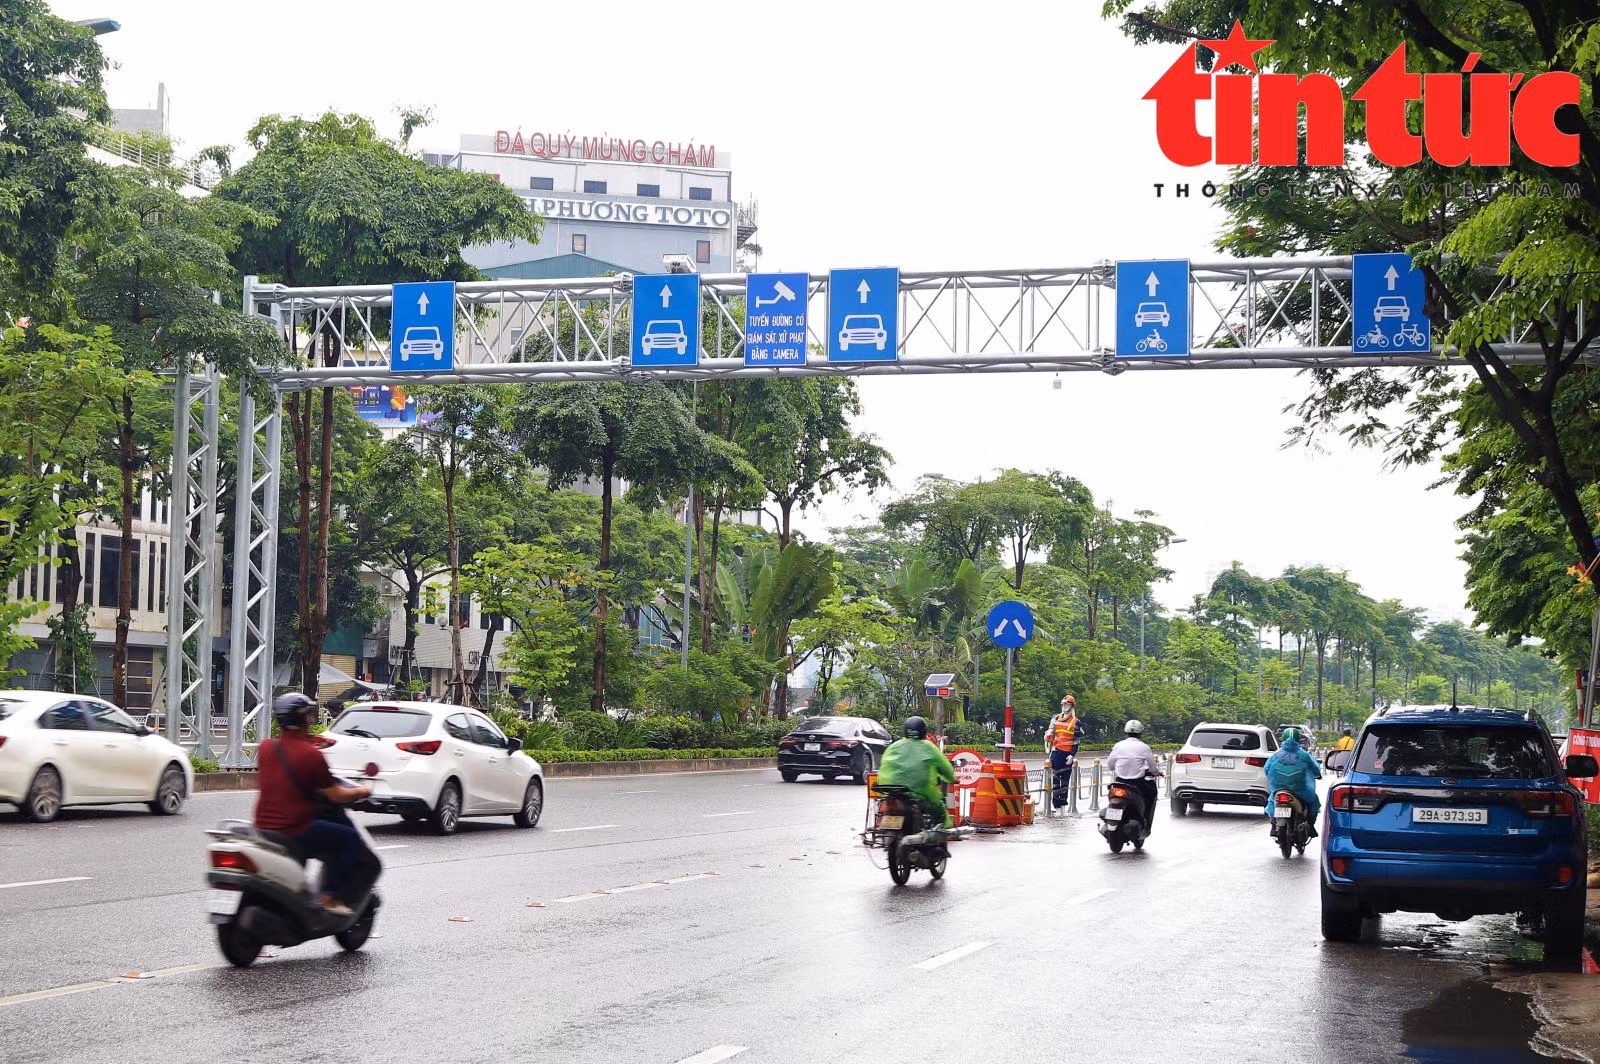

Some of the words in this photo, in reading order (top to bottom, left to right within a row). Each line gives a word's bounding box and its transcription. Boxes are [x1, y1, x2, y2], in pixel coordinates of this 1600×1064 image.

[495, 126, 526, 154] ĐÁ
[530, 129, 577, 159] QUÝ
[542, 199, 649, 222] PHƯƠNG
[655, 206, 731, 227] TOTO
[749, 312, 770, 327] TUYẾN
[772, 313, 793, 327] ĐƯỜNG
[795, 313, 805, 327] CÓ
[747, 331, 763, 344] GIÁM
[778, 329, 788, 344] XỬ
[789, 332, 805, 345] PHẠT
[751, 345, 768, 360] BẰNG
[772, 348, 799, 360] CAMERA
[1419, 810, 1482, 822] 29A-973.93
